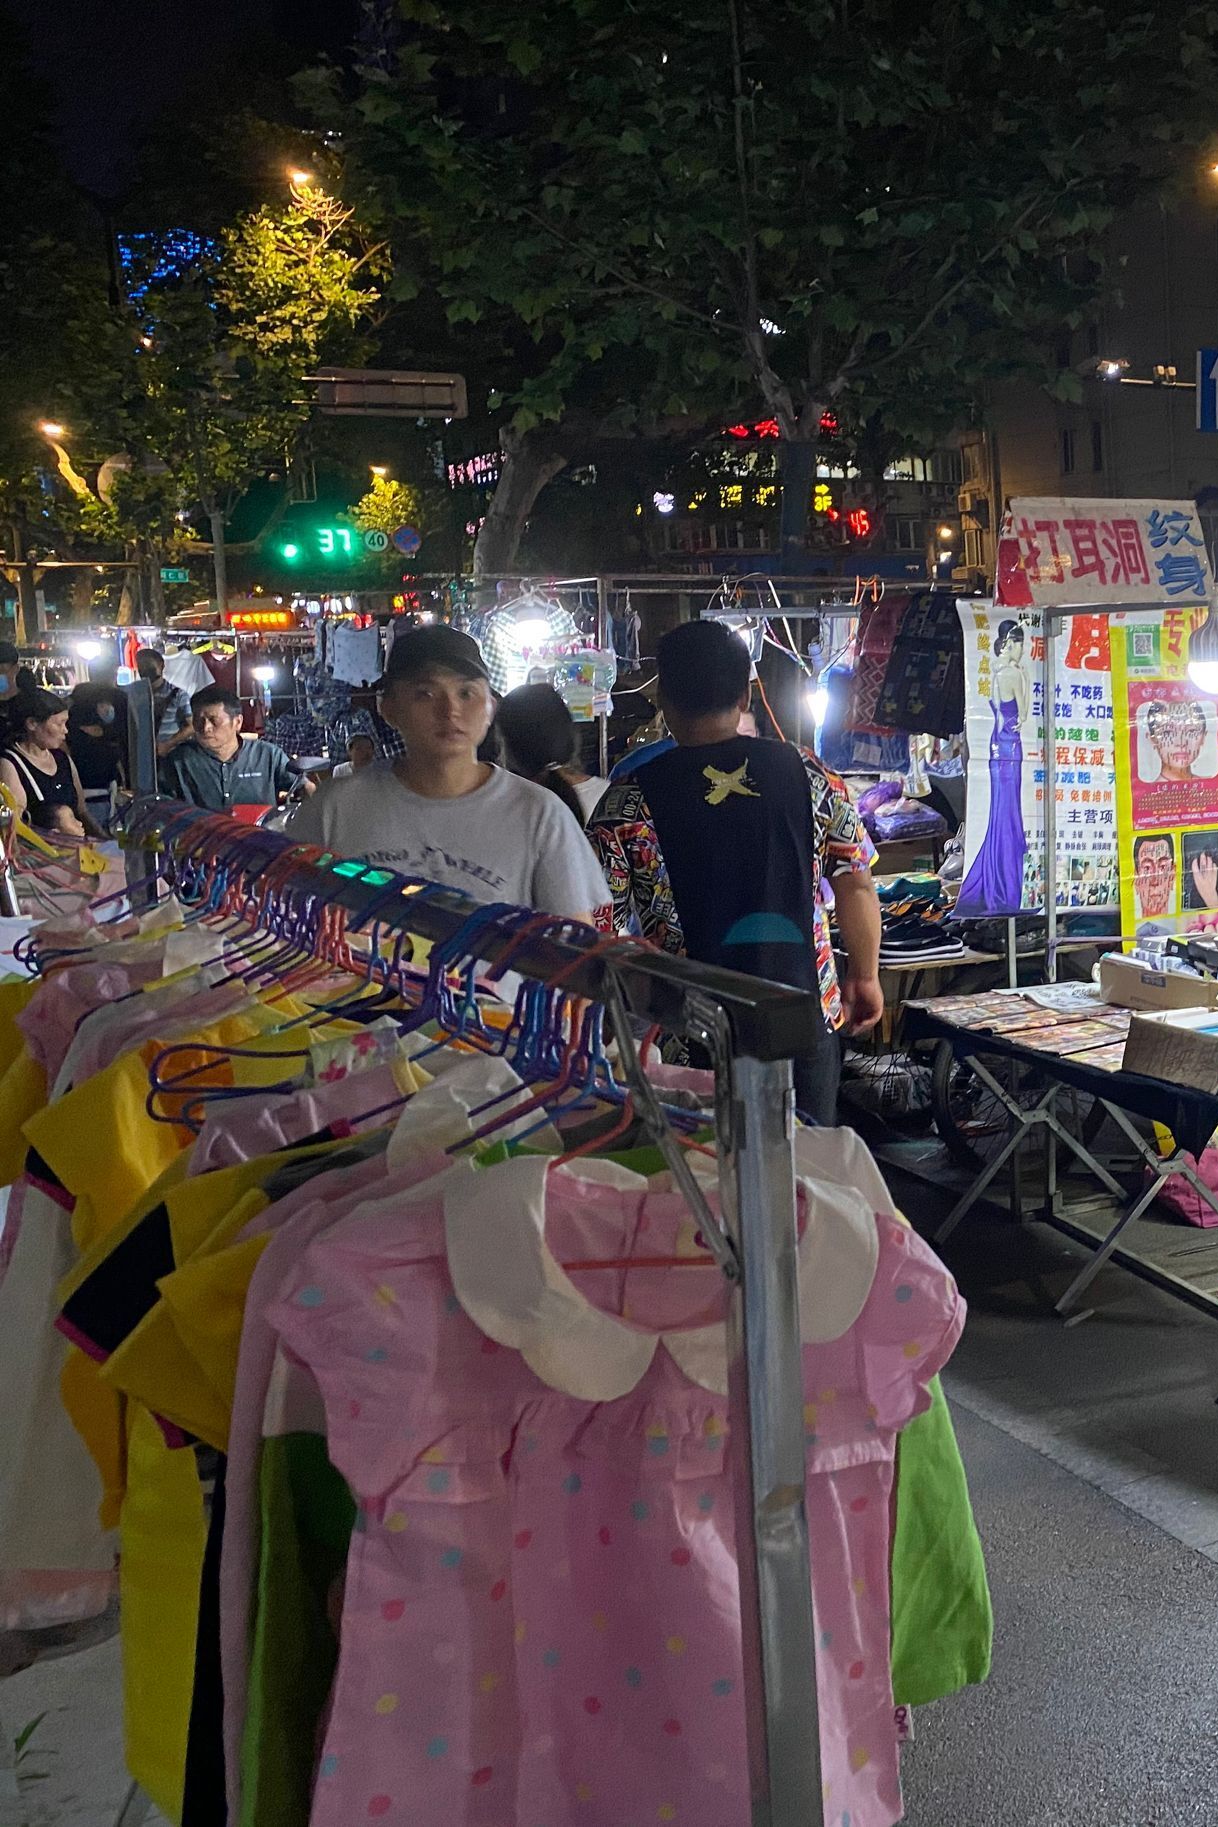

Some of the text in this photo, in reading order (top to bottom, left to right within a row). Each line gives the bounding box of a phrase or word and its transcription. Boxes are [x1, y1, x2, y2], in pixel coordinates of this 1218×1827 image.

[315, 528, 350, 553] 37
[367, 534, 385, 547] 40
[1017, 517, 1151, 585] 打耳洞
[1145, 509, 1207, 596] 纹身
[970, 602, 992, 699] 肥终点站
[1071, 685, 1103, 700] 不吃药
[1032, 702, 1072, 717] 三吃饱
[1067, 809, 1113, 824] 主营项
